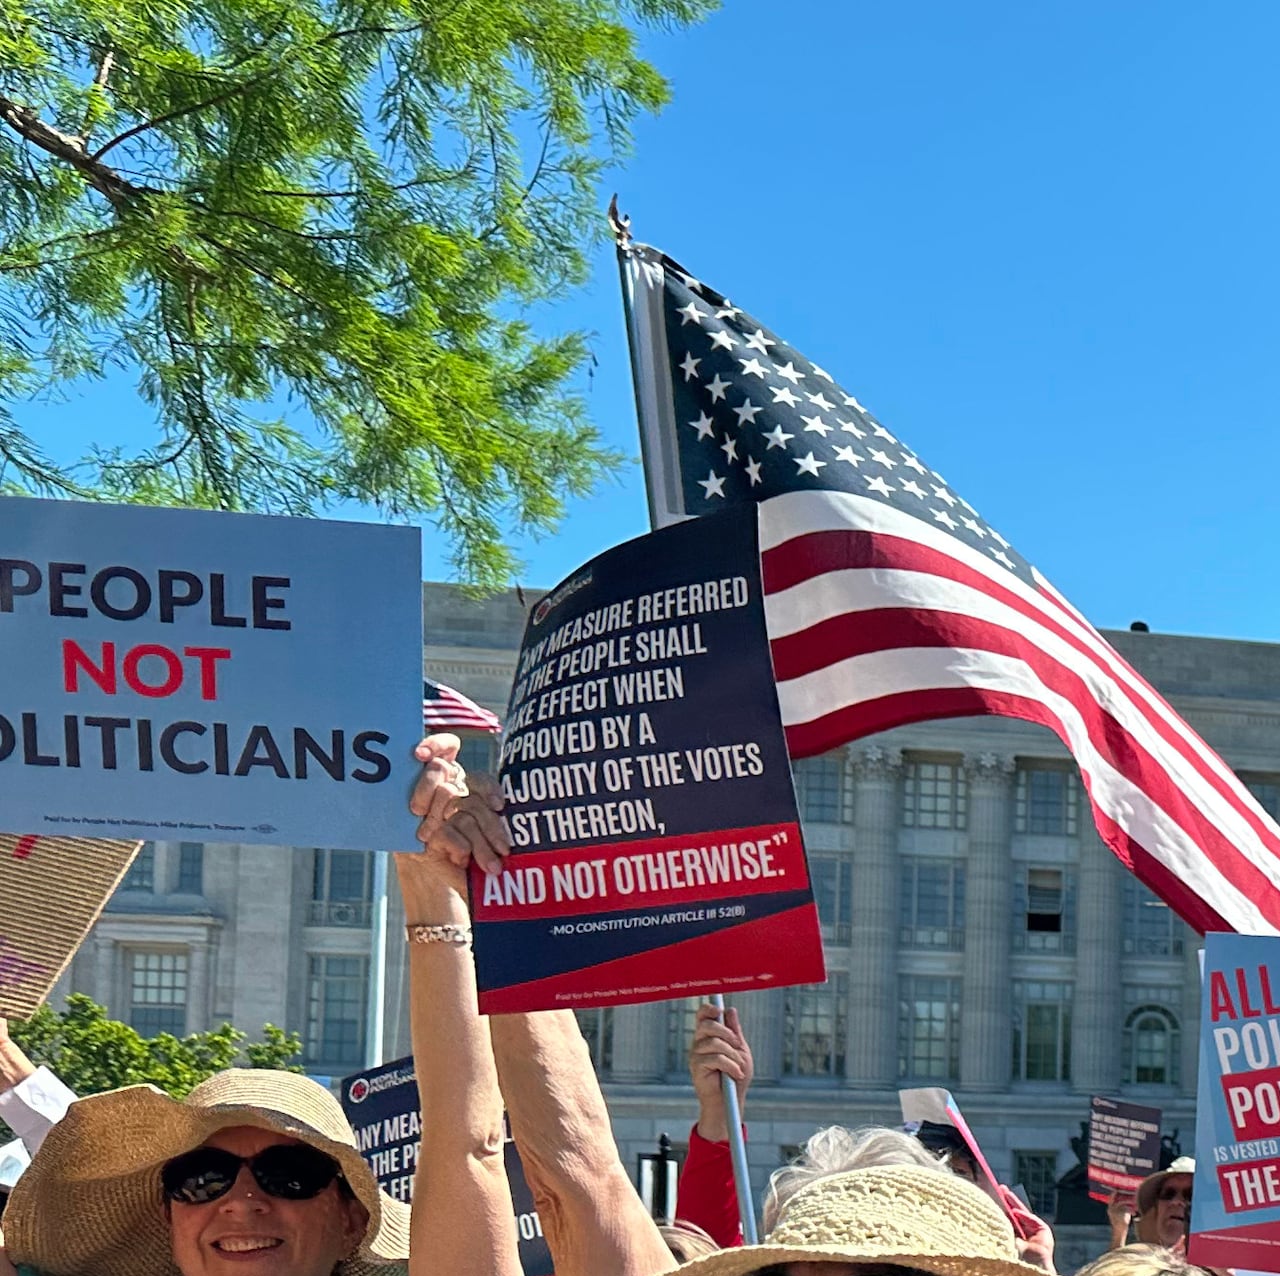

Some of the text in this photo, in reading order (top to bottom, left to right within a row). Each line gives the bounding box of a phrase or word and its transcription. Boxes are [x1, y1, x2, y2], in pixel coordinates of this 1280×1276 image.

[0, 559, 292, 630] PEOPLE
[546, 599, 633, 657] MEASURE
[638, 576, 748, 624] REFERRED
[63, 639, 231, 700] NOT
[558, 623, 707, 681] PEOPLE SHALL
[537, 667, 684, 723] EFFECT WHEN
[0, 714, 391, 783] LITICIANS
[602, 713, 656, 750] BY A
[603, 743, 764, 792] OF THE VOTES
[543, 799, 666, 842] THEREON,
[483, 867, 546, 907] AND
[552, 859, 608, 902] NOT
[576, 910, 704, 933] CONSTITUTION ARTICLE
[1214, 1147, 1228, 1163] IS
[1230, 1141, 1277, 1159] VESTED
